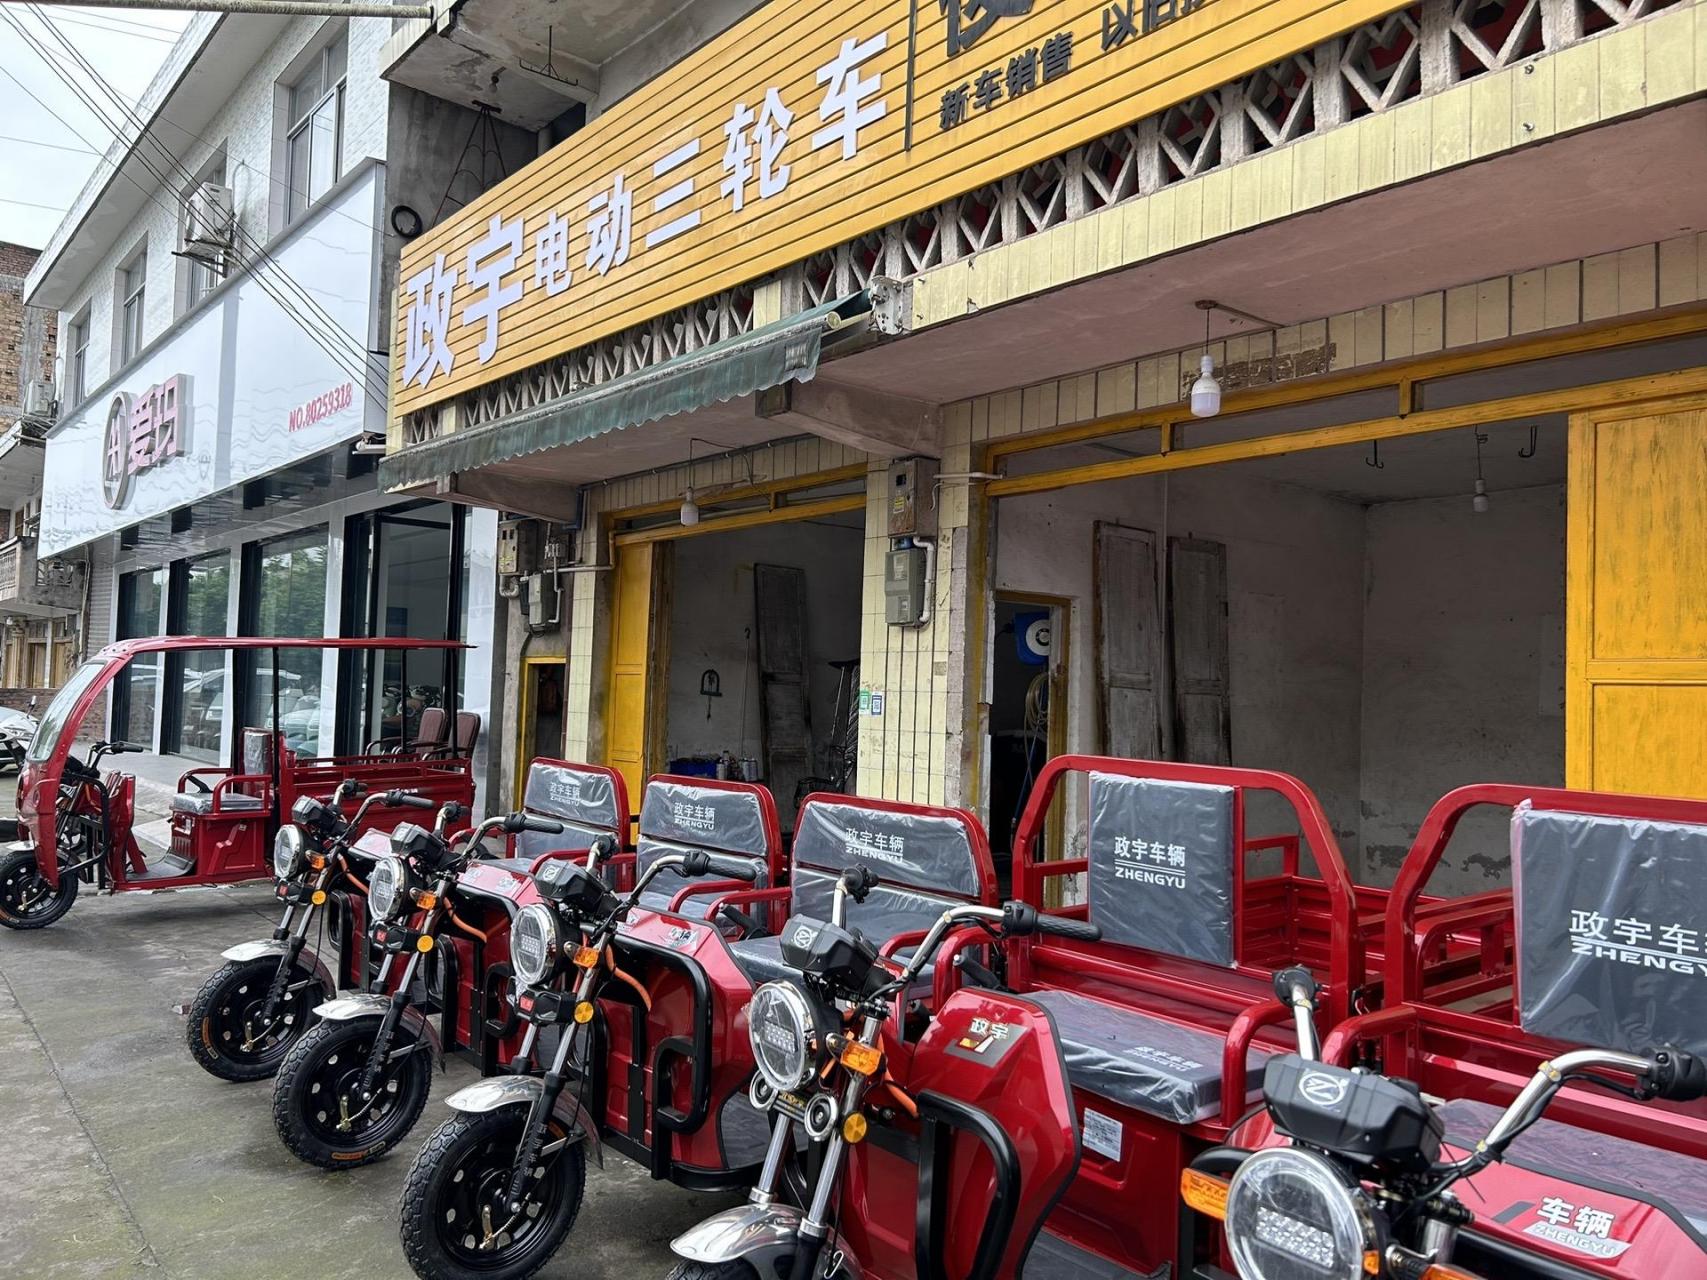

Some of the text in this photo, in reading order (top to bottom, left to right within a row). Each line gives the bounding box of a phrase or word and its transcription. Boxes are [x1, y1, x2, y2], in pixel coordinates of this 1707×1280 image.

[939, 31, 1073, 131] 新车销售
[403, 32, 888, 389] 政宇电动三轮车
[674, 801, 716, 820] 政宇车辆
[674, 818, 715, 831] ZHENGYU
[845, 827, 905, 853] 政宇车辆
[1114, 836, 1186, 867] 政宇车辆
[845, 846, 904, 864] ZHENGYU
[1115, 866, 1186, 889] ZHENGYU
[1569, 909, 1707, 955] 政宇车
[969, 1017, 1009, 1040] 政宇
[1537, 1197, 1615, 1239] 车辆
[1534, 1224, 1615, 1256] ZHENGYU
